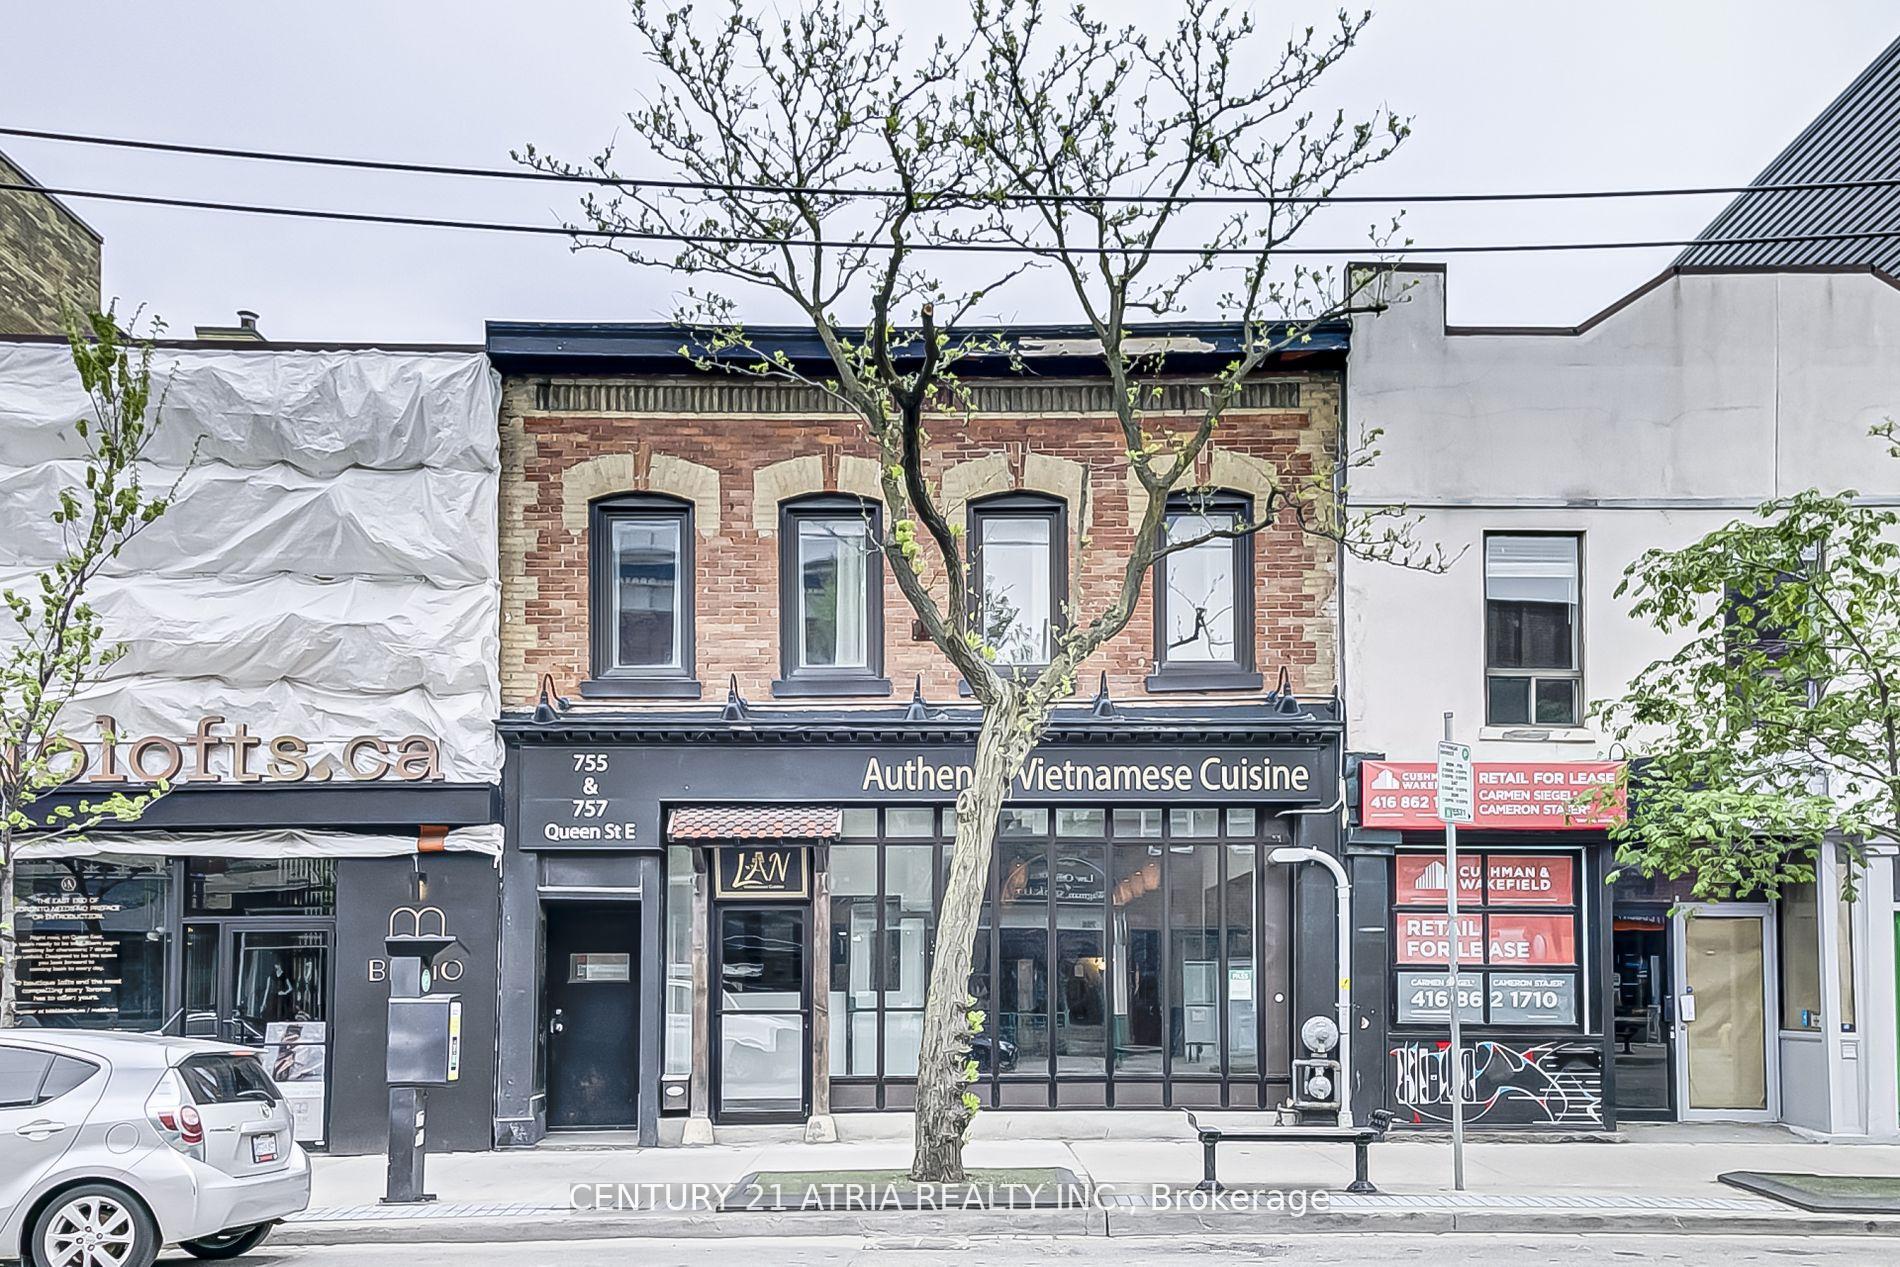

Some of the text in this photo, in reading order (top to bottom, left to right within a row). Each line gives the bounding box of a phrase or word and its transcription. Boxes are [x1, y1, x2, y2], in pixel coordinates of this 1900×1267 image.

[5, 714, 445, 782] olofts.ca
[573, 754, 608, 772] 755
[862, 757, 1310, 792] Authen Vietnamese Cuisine
[1401, 772, 1438, 781] CUSHM
[1478, 772, 1529, 784] RETAIL
[1533, 772, 1565, 785] FOR
[1569, 773, 1616, 785] LEASE
[583, 777, 598, 795] &
[1370, 796, 1397, 809] 416
[1400, 796, 1430, 809] 862
[1478, 789, 1530, 801] CARMEN
[572, 800, 608, 818] 757
[1478, 804, 1540, 815] CAMERON
[544, 823, 636, 841] Queen St E
[732, 851, 791, 888] LAN
[1459, 866, 1550, 878] CUHMAN &
[1459, 879, 1551, 890] WAKEFIELD
[1407, 920, 1480, 936] RETAIL
[1407, 941, 1529, 958] FOR LEASE
[368, 959, 464, 981] BIO
[1411, 990, 1449, 1007] 416
[1510, 991, 1558, 1008] 1710
